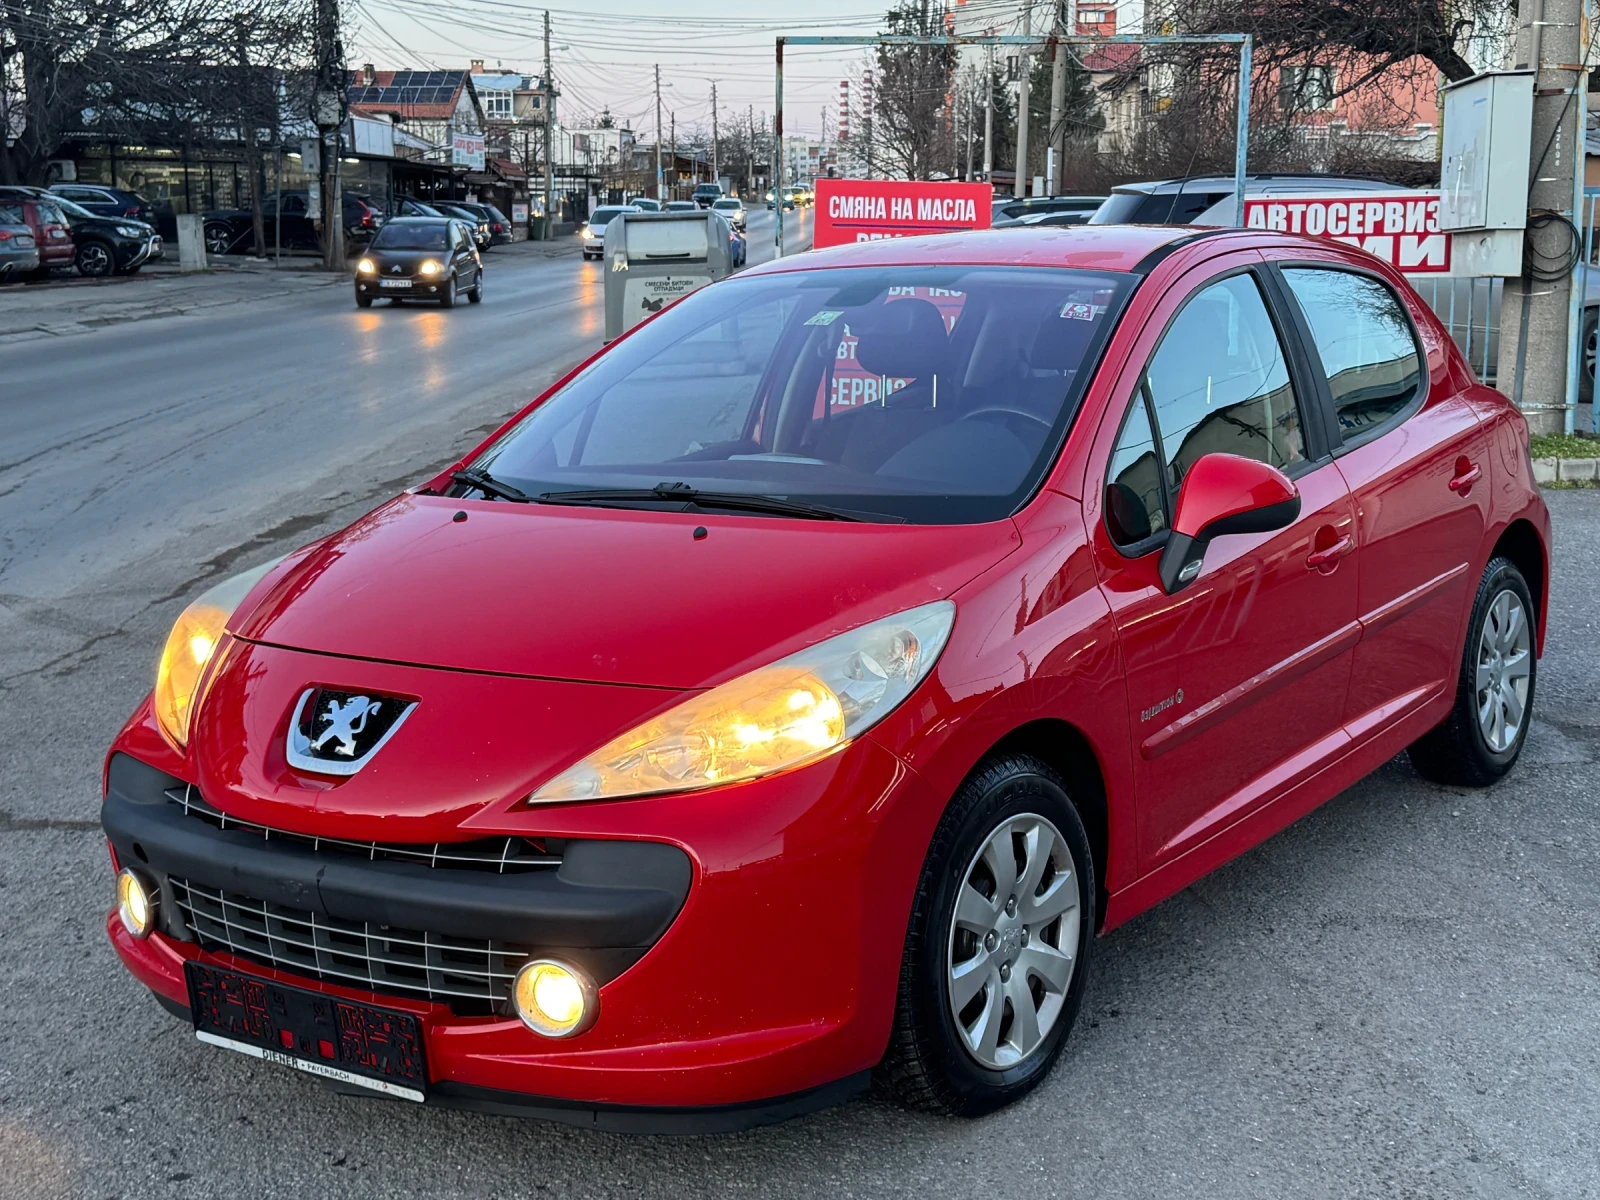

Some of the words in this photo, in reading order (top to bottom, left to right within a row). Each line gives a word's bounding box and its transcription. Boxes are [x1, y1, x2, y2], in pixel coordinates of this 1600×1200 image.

[829, 195, 887, 220] СМЯНА
[891, 197, 914, 221] НА
[917, 198, 977, 222] МАСЛА
[1247, 200, 1441, 236] АВТОСЕРВИЗ
[262, 1049, 299, 1069] DIENER
[307, 1063, 350, 1081] PAYERBACH
